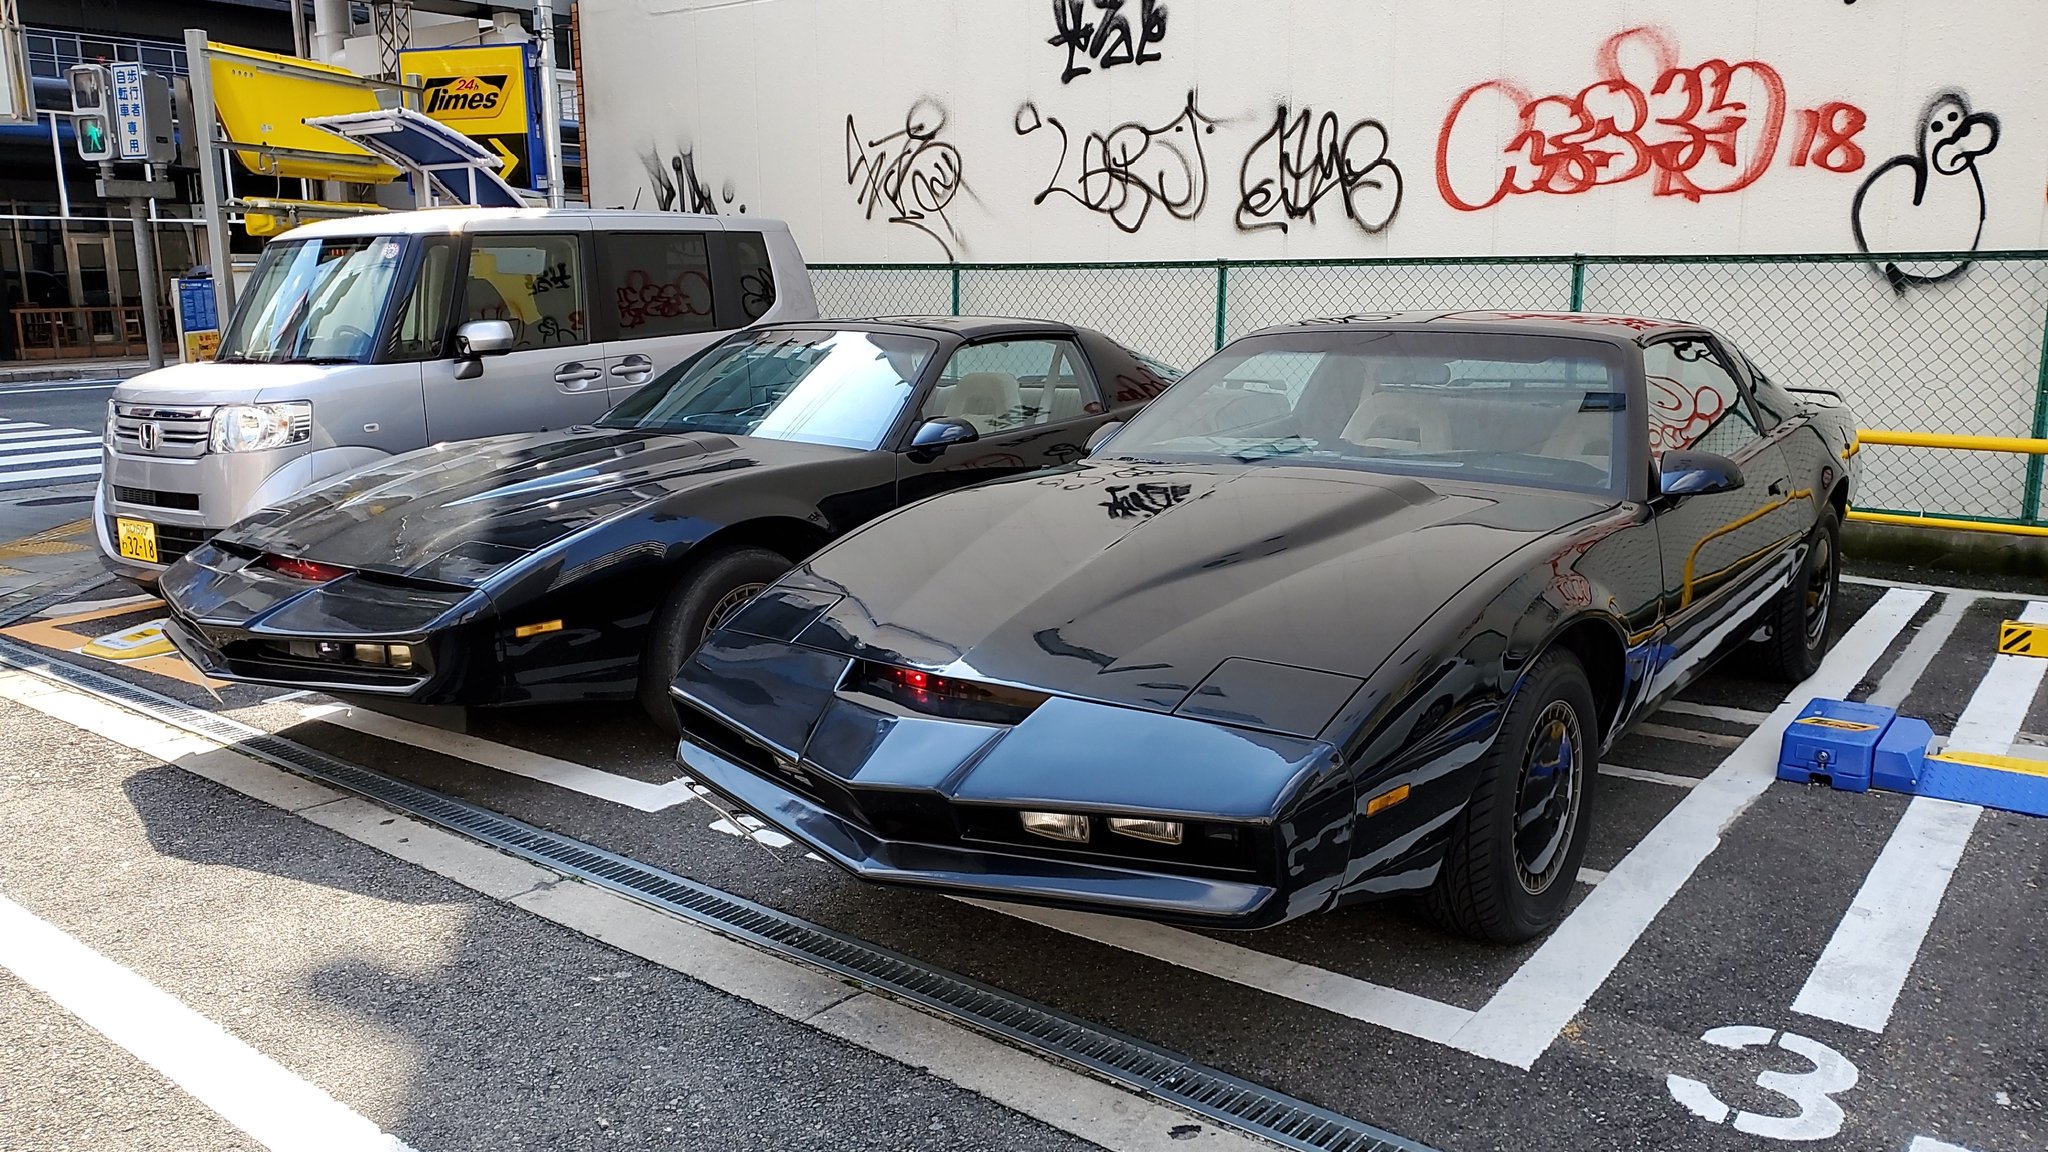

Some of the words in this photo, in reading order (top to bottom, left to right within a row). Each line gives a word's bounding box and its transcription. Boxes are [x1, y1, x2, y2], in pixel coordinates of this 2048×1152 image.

[116, 71, 130, 117] 自転車
[127, 70, 141, 117] 歩行者
[456, 79, 479, 91] 24h
[127, 121, 139, 152] 専用
[1789, 101, 1867, 173] 18
[1666, 1025, 1859, 1141] 3
